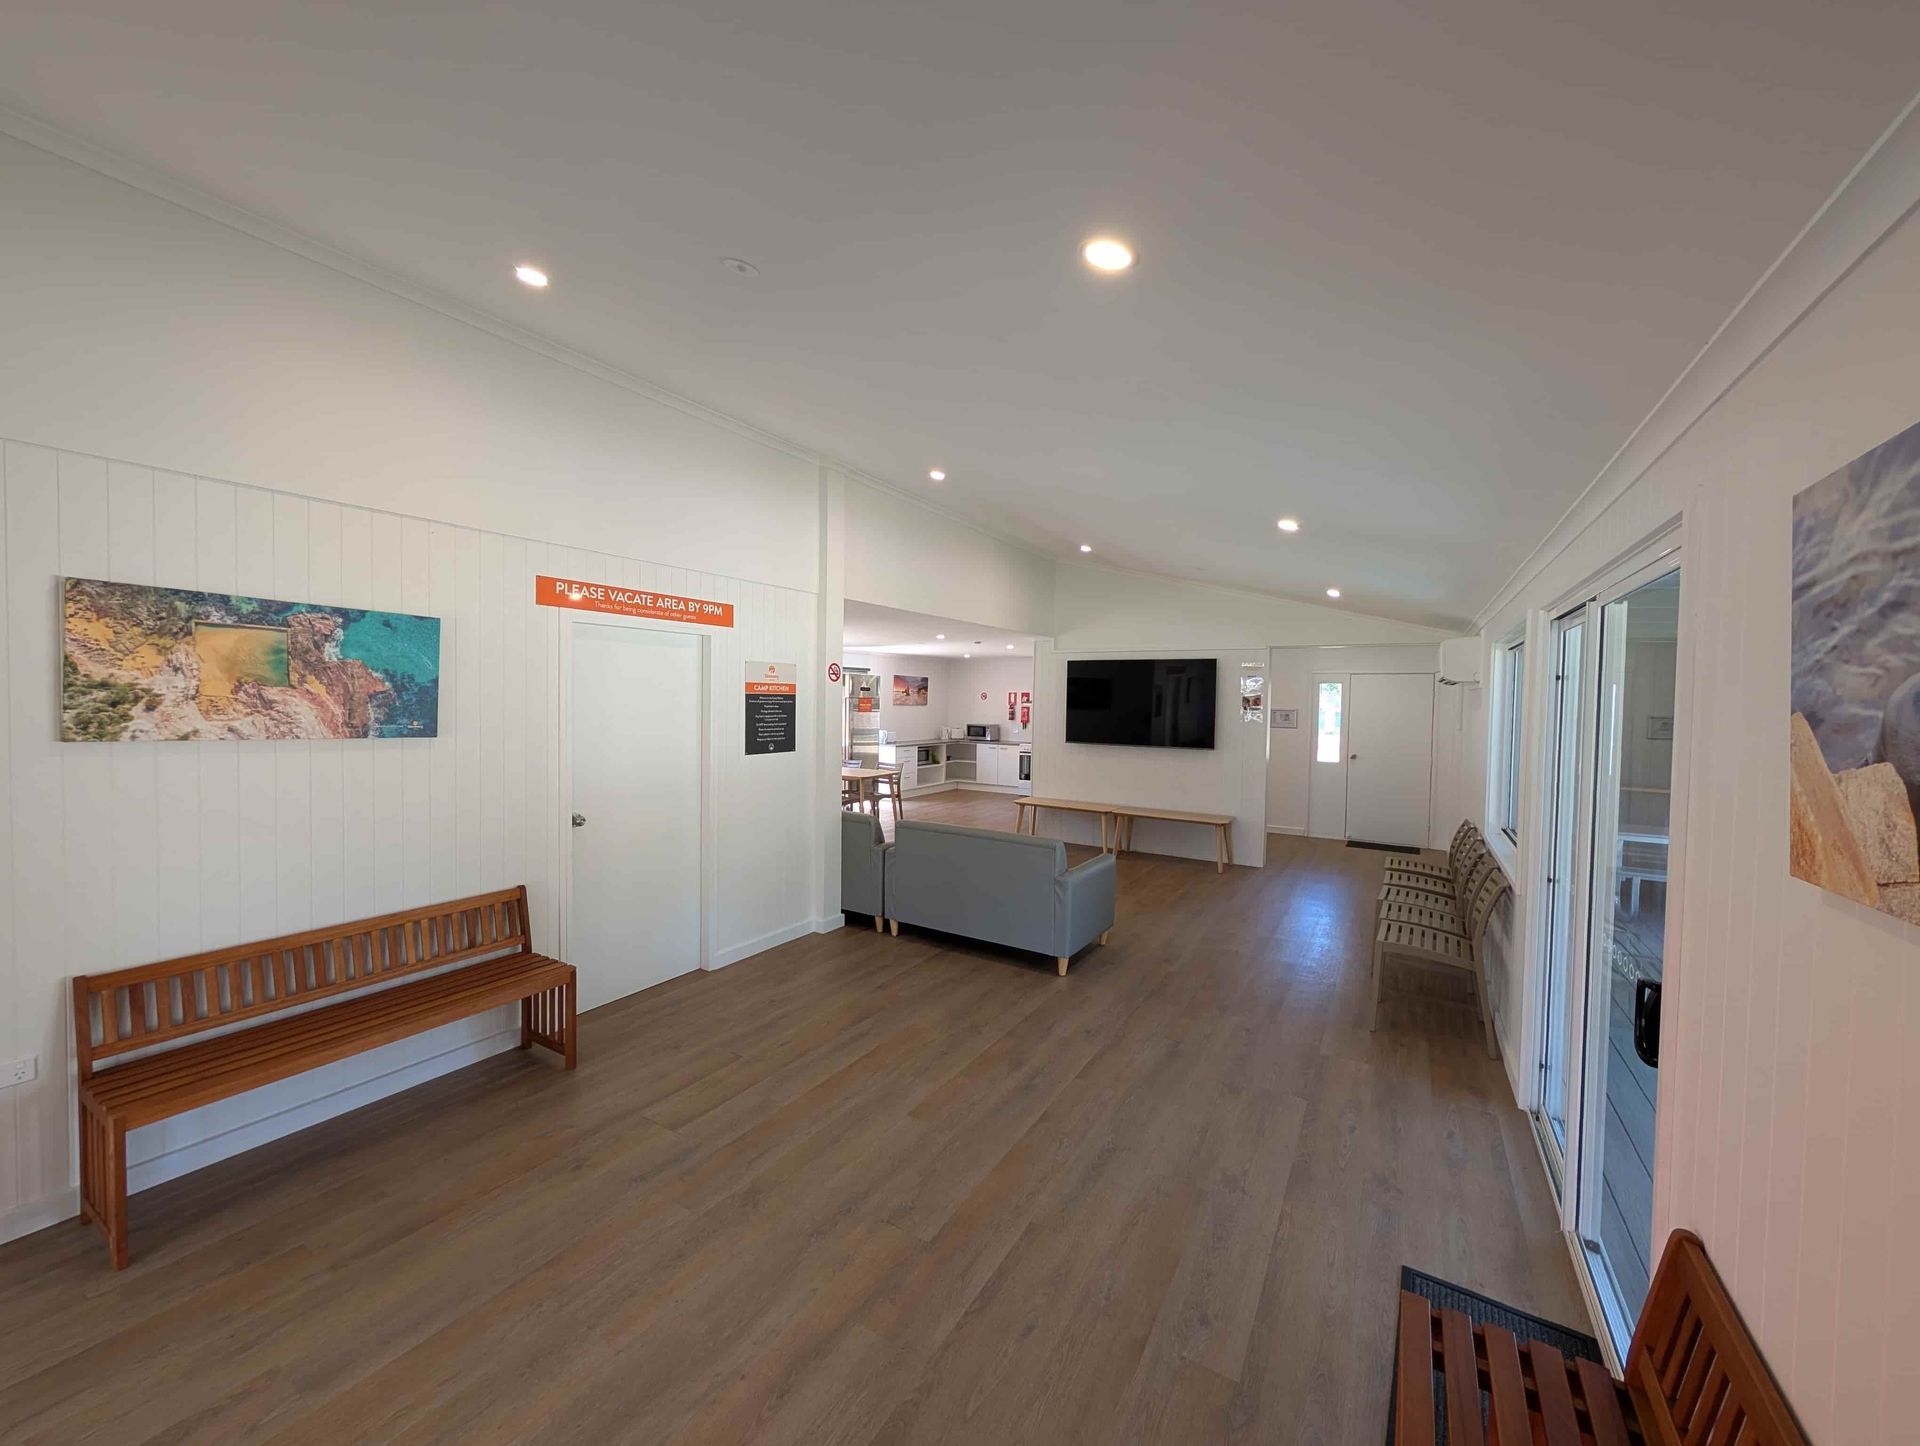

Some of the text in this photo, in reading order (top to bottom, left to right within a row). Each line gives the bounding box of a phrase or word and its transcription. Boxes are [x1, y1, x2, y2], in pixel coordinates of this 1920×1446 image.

[556, 582, 723, 616] PLEASE VACATE AREA BY 9PM
[595, 601, 613, 609] Thanks
[614, 602, 622, 610] for
[622, 604, 636, 614] being
